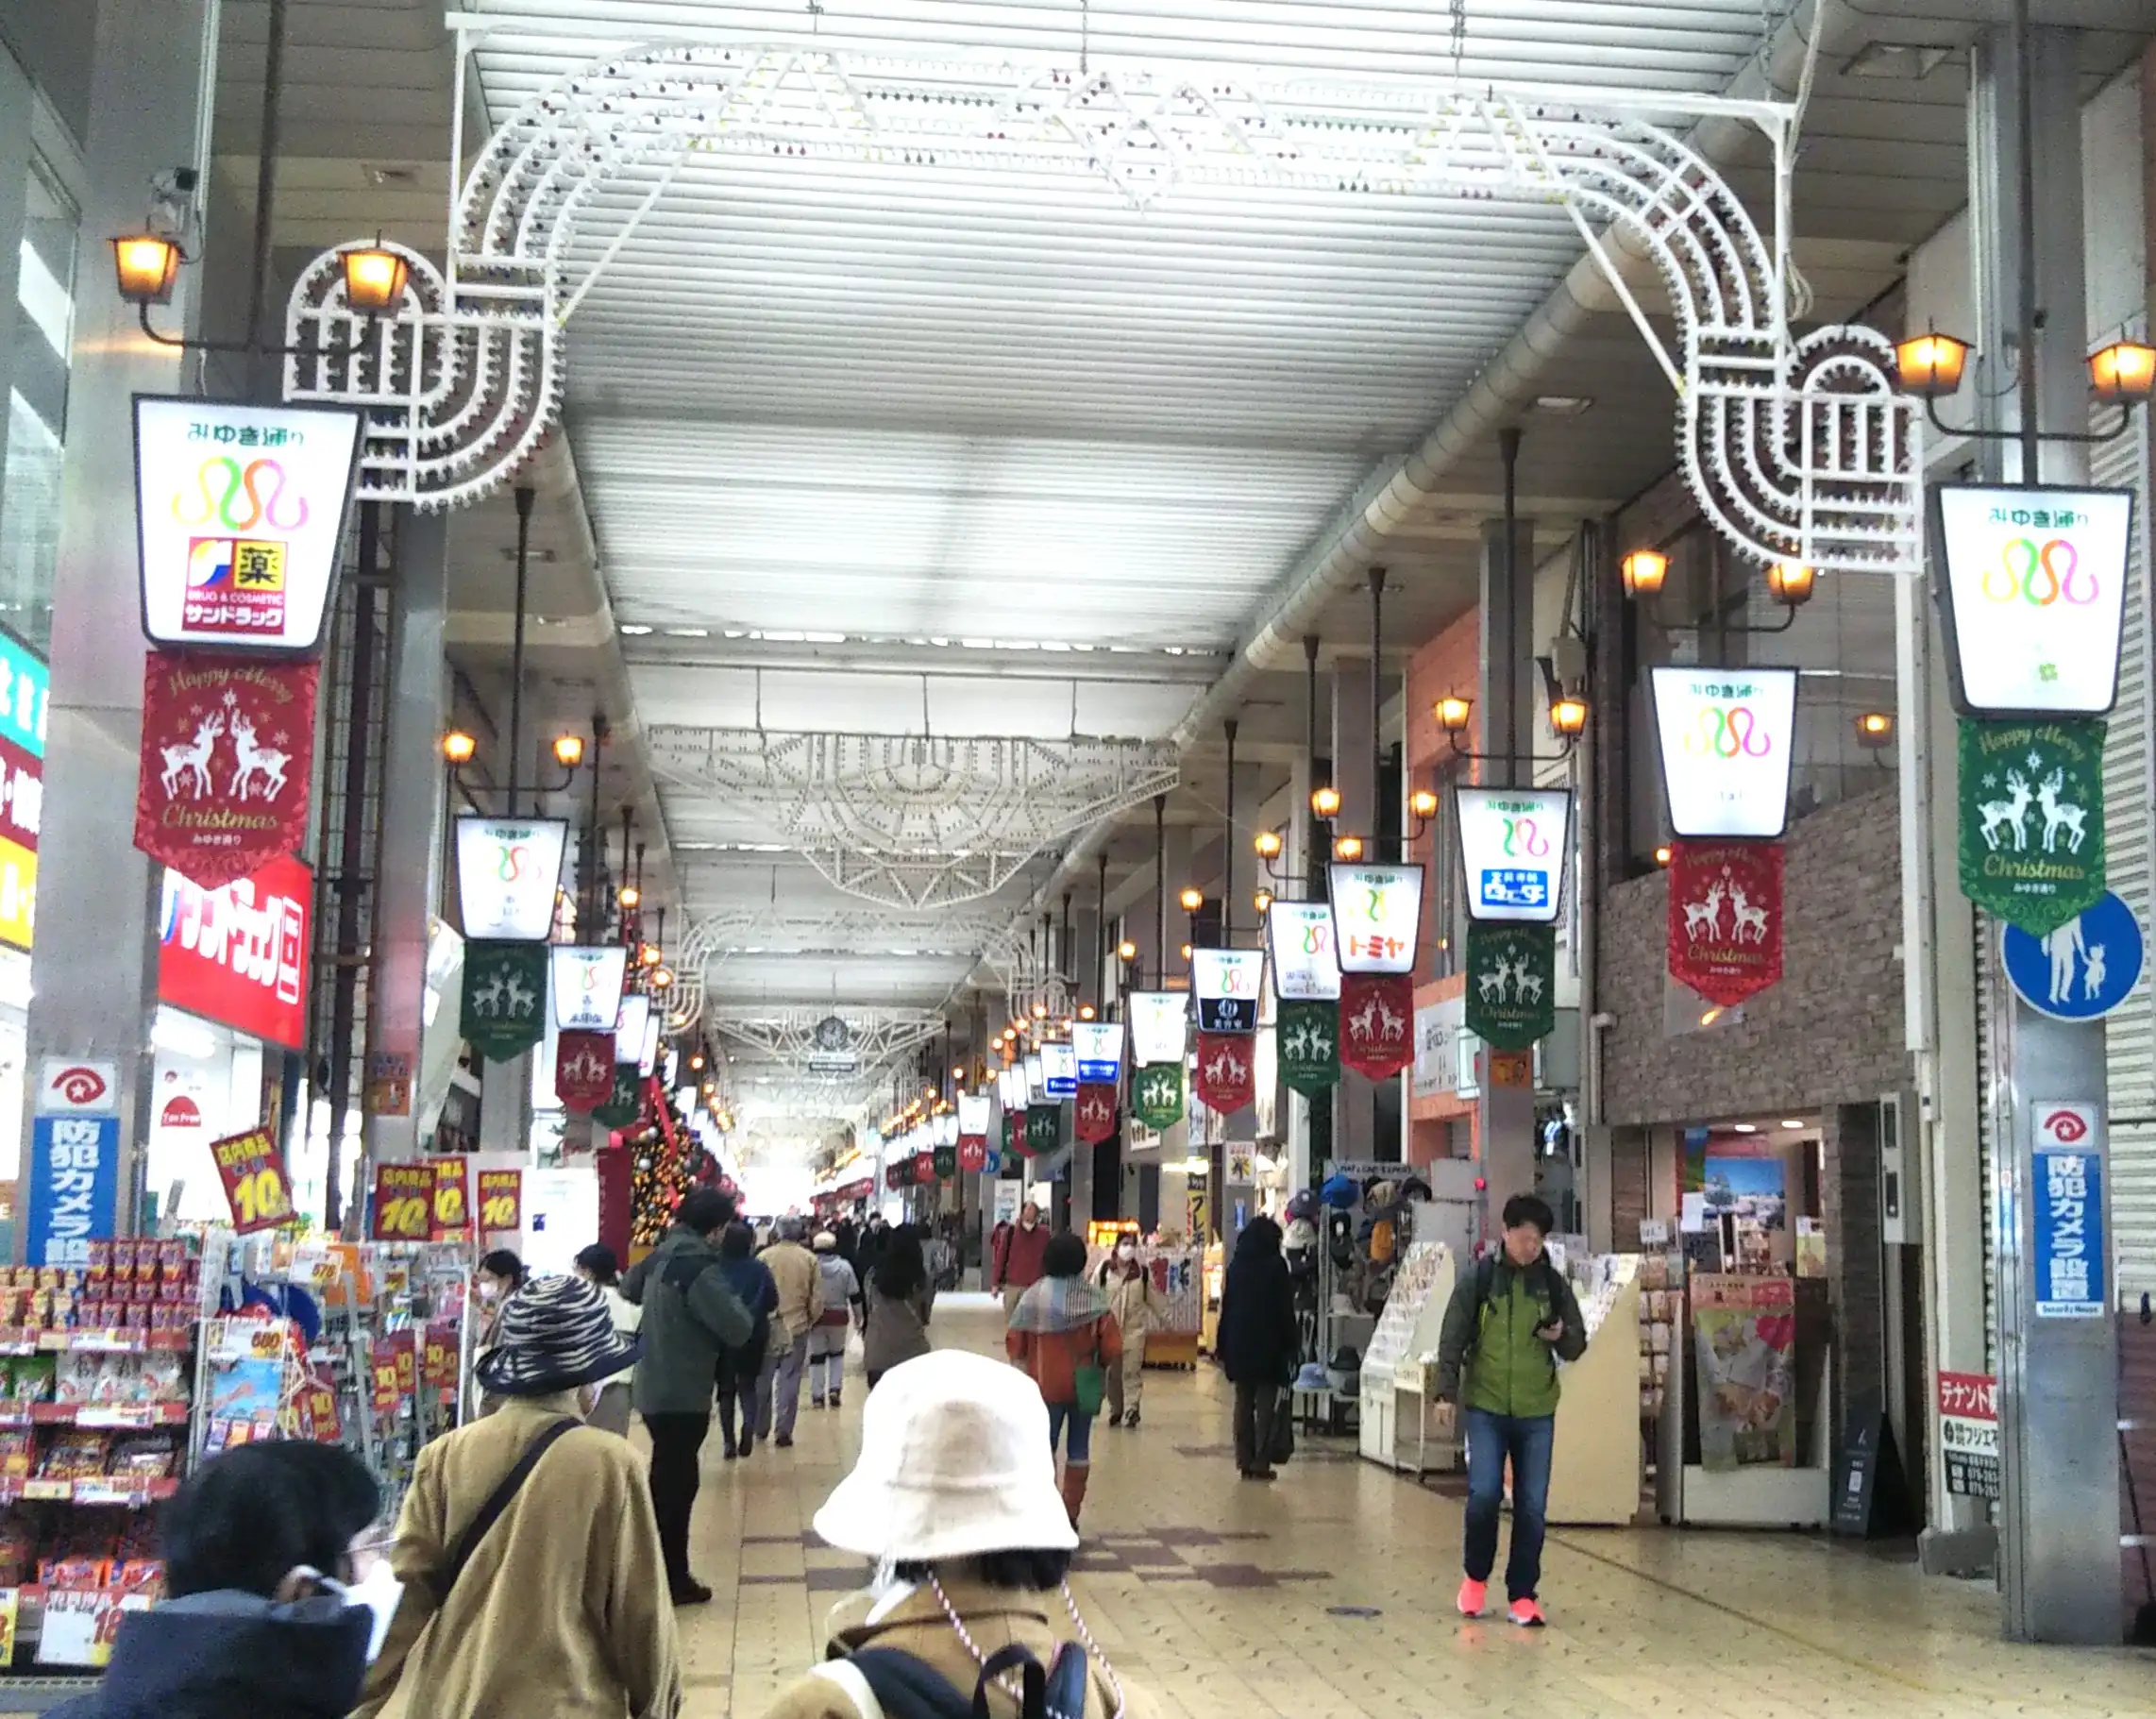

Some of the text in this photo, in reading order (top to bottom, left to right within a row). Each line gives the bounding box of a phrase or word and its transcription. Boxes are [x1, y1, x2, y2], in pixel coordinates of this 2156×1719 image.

[188, 422, 305, 447] みゆき通り
[1989, 507, 2088, 529] みゆき通り
[238, 548, 280, 583] 薬
[168, 667, 230, 697] Happy
[1979, 724, 2031, 755] Happy
[161, 801, 278, 830] Christmas
[1982, 854, 2085, 880] Christmas
[1350, 935, 1405, 959] トミヤ
[1687, 943, 1763, 964] Christmas
[47, 1120, 101, 1270] 防犯カメラ設
[233, 1168, 281, 1223] 10
[381, 1197, 428, 1235] 10
[2047, 1154, 2090, 1301] 防犯カメラ設置
